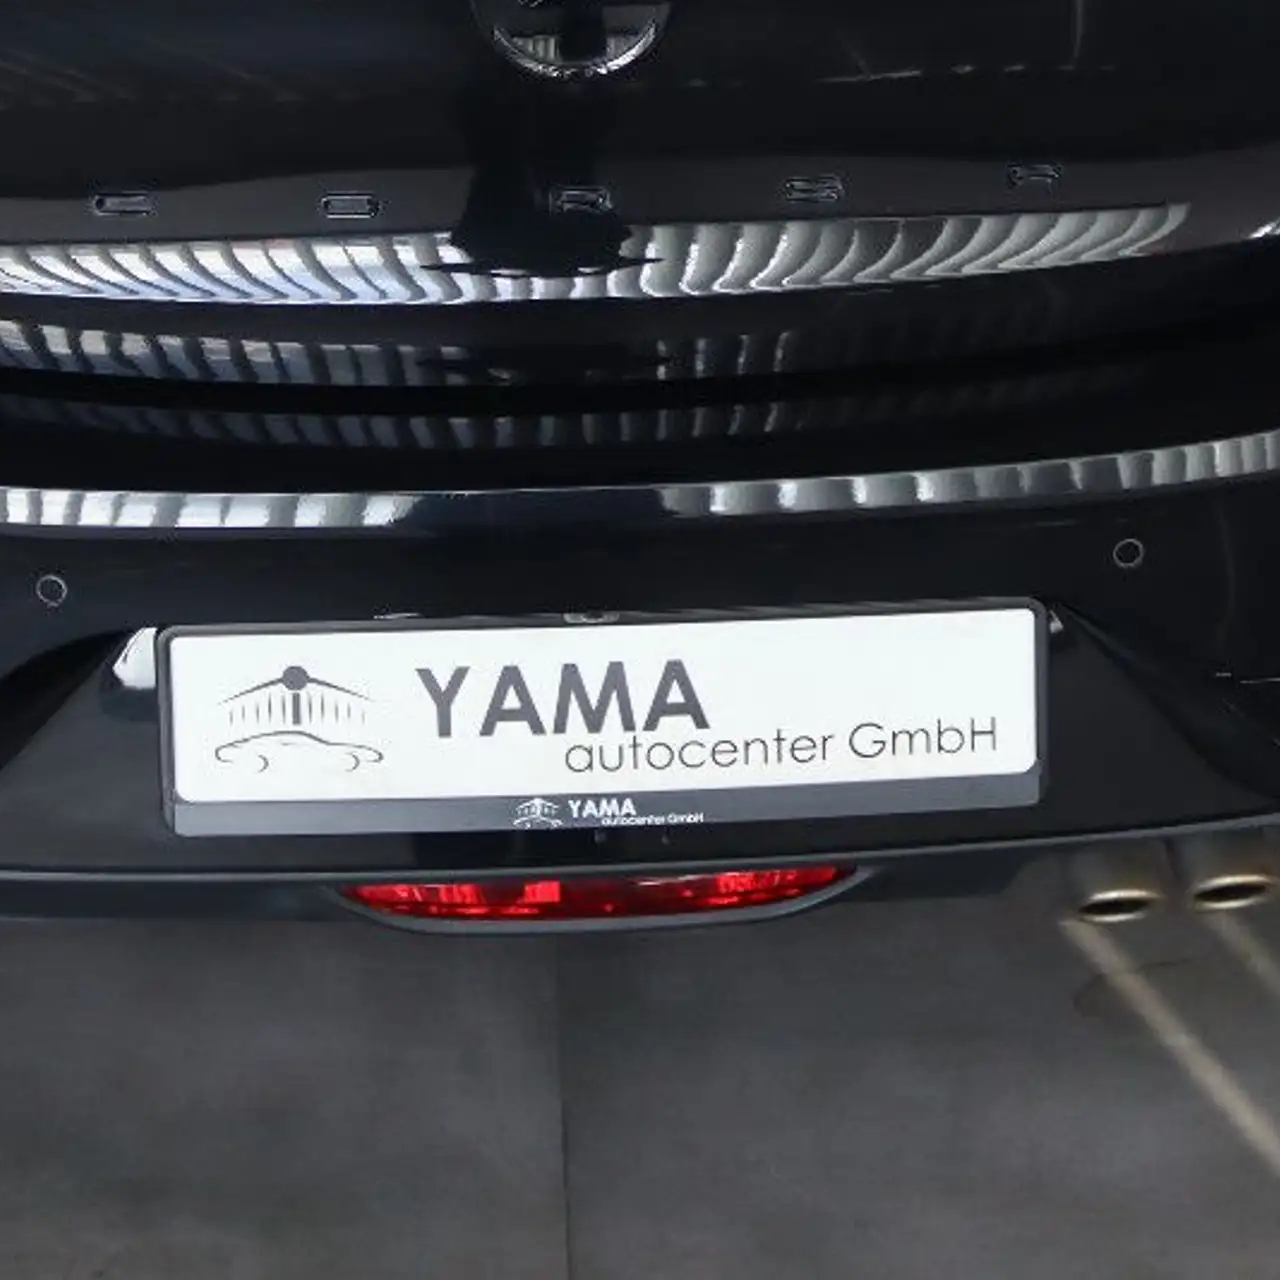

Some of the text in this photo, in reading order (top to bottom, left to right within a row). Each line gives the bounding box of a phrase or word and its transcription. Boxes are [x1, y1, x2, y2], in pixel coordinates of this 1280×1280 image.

[415, 659, 711, 738] YAMA
[565, 717, 996, 773] autocenter GmbH
[568, 797, 637, 819] YAMA
[667, 812, 705, 824] GmbH
